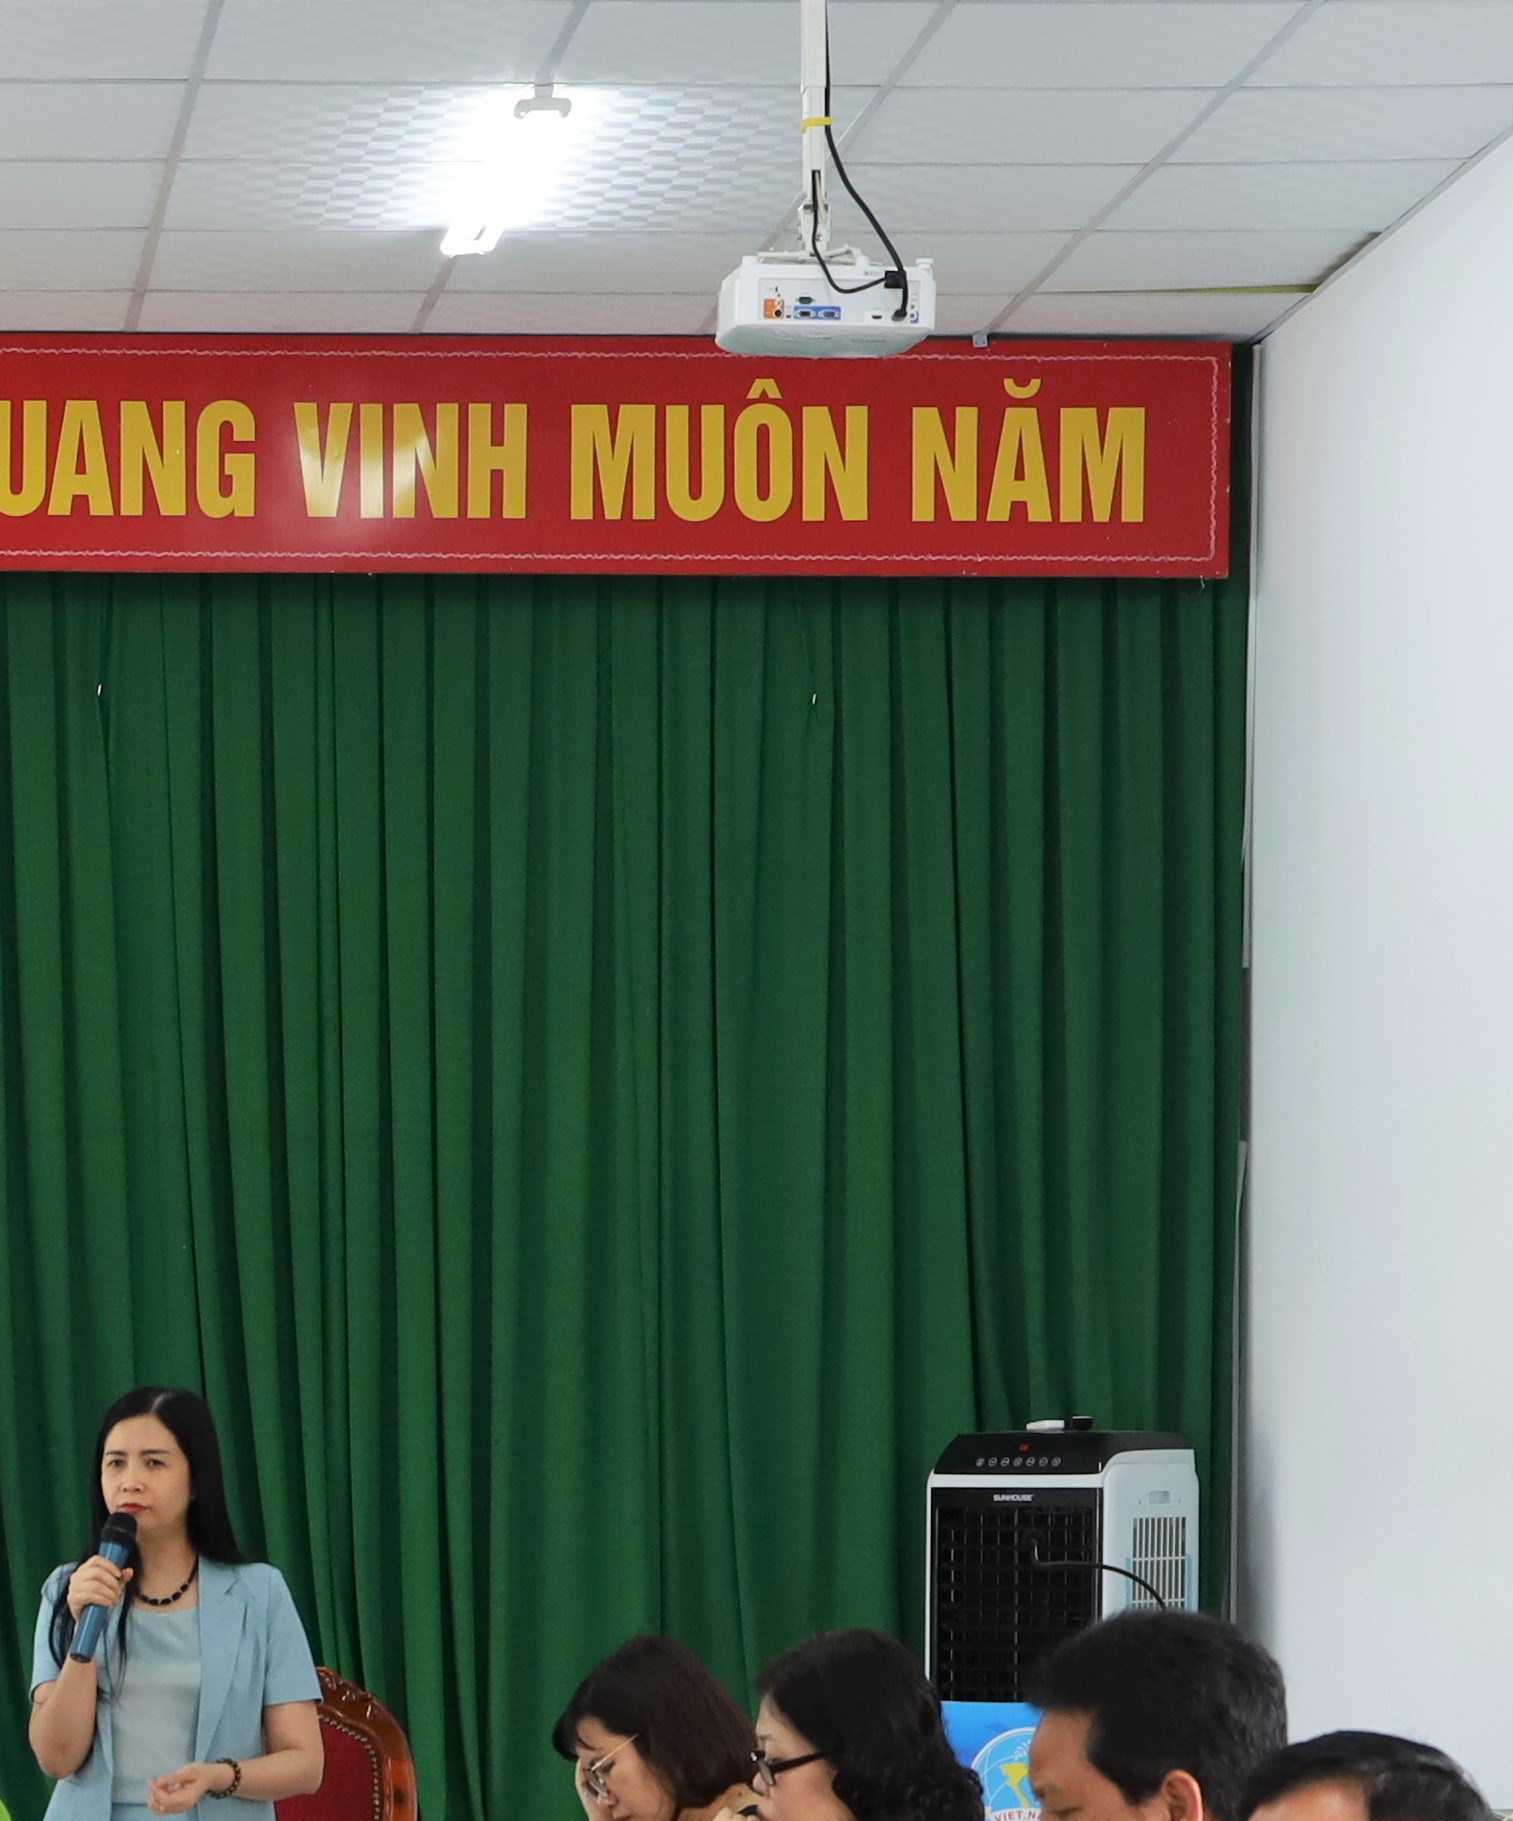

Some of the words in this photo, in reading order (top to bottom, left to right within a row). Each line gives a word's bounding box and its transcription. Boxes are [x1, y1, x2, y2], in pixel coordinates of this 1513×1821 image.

[293, 402, 527, 520] VINH
[576, 378, 868, 523] MUÔN
[910, 378, 1145, 524] NĂM
